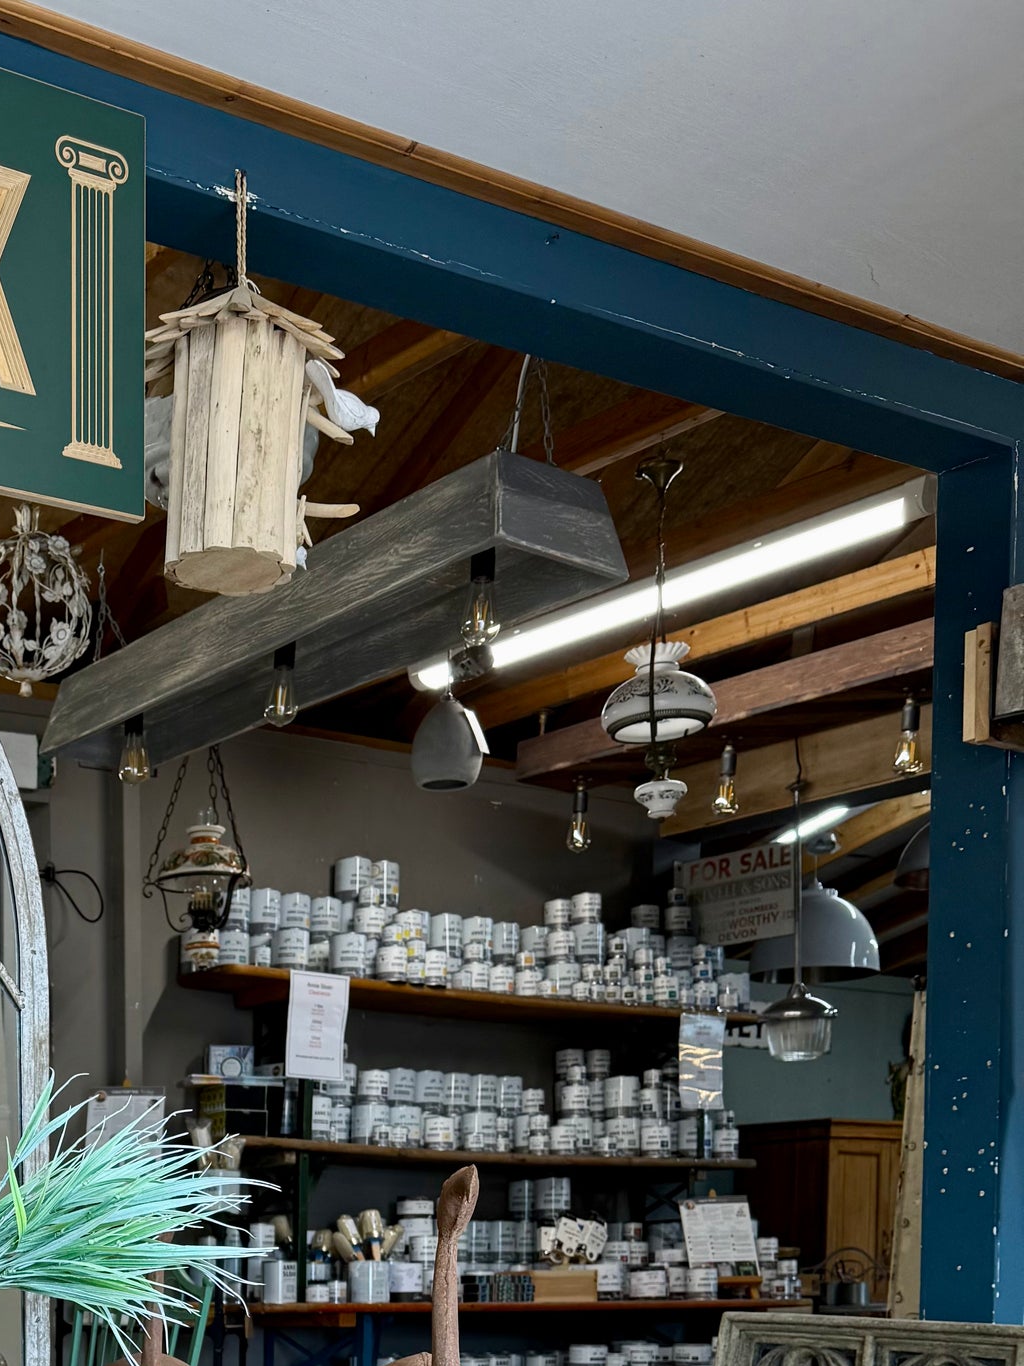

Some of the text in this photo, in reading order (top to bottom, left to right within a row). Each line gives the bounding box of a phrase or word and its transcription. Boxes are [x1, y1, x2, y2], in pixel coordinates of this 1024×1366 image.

[689, 845, 792, 885] FOR SALE
[718, 927, 758, 943] DEVON
